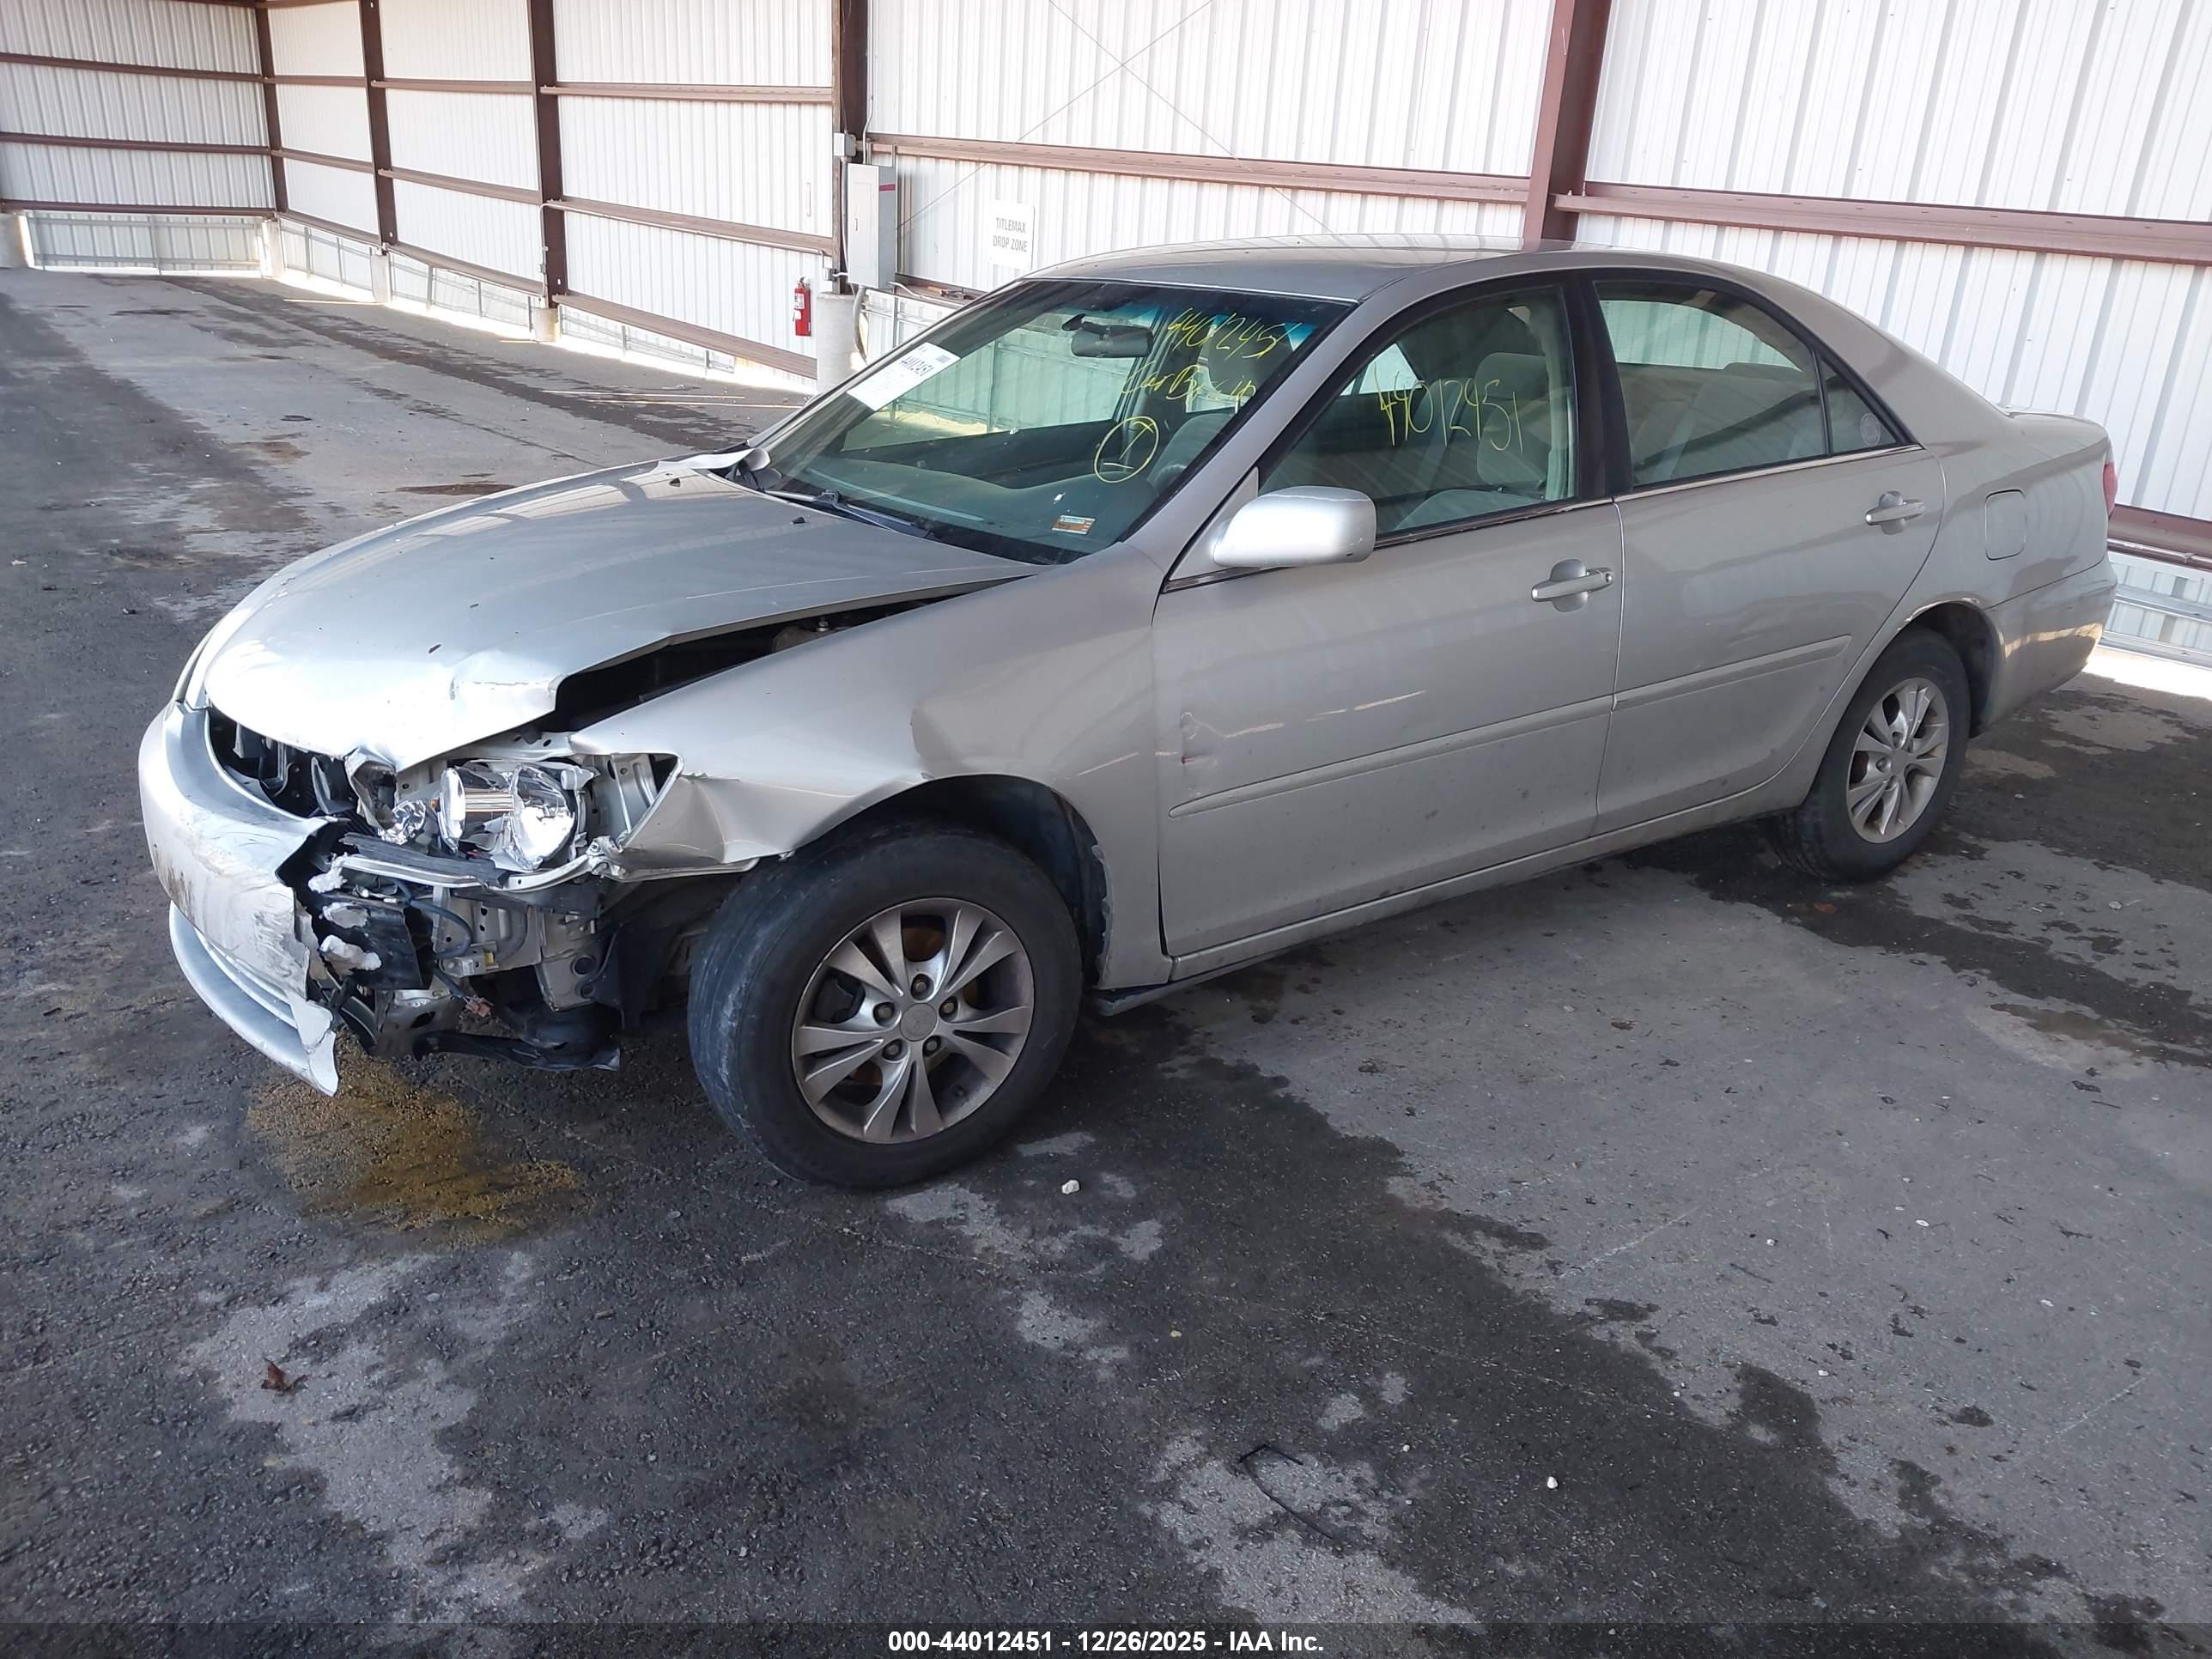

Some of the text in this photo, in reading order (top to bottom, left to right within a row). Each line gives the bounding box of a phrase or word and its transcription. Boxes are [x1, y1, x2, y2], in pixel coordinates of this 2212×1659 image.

[996, 217, 1026, 234] TITLEMAX
[993, 235, 1028, 252] DROP ZONE
[1374, 362, 1523, 453] 44012451
